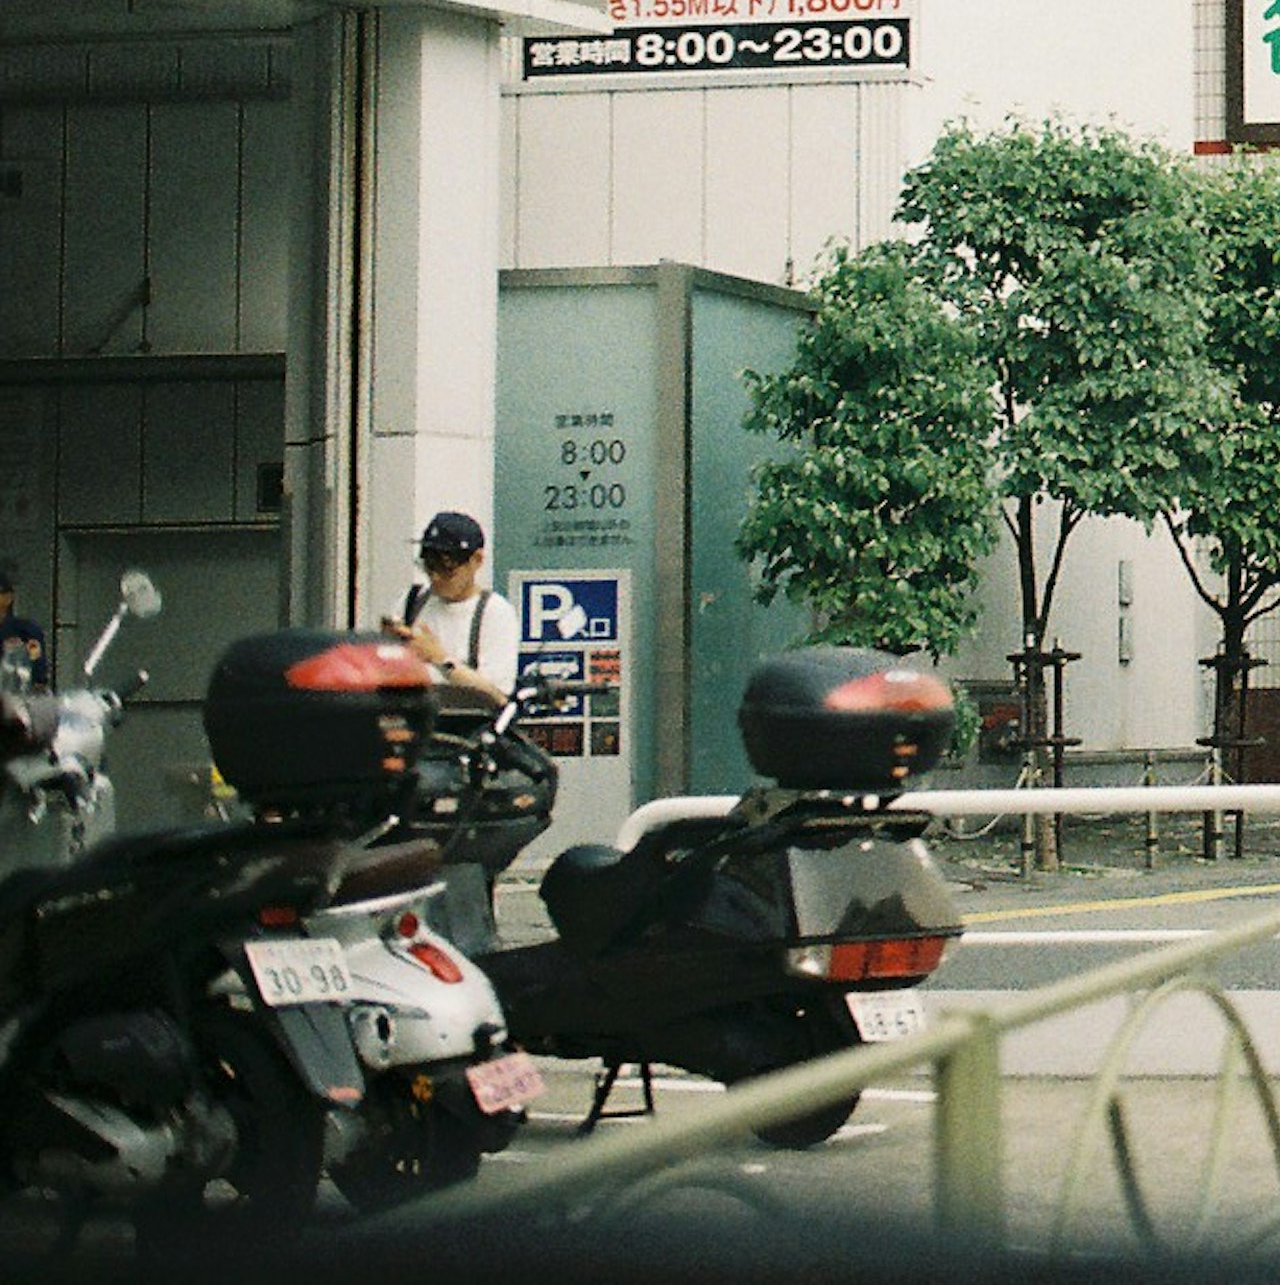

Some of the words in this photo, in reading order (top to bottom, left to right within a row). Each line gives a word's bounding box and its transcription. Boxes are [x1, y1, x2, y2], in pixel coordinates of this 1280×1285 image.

[561, 439, 626, 465] 8:00
[544, 483, 626, 510] 23:00
[528, 584, 573, 640] P
